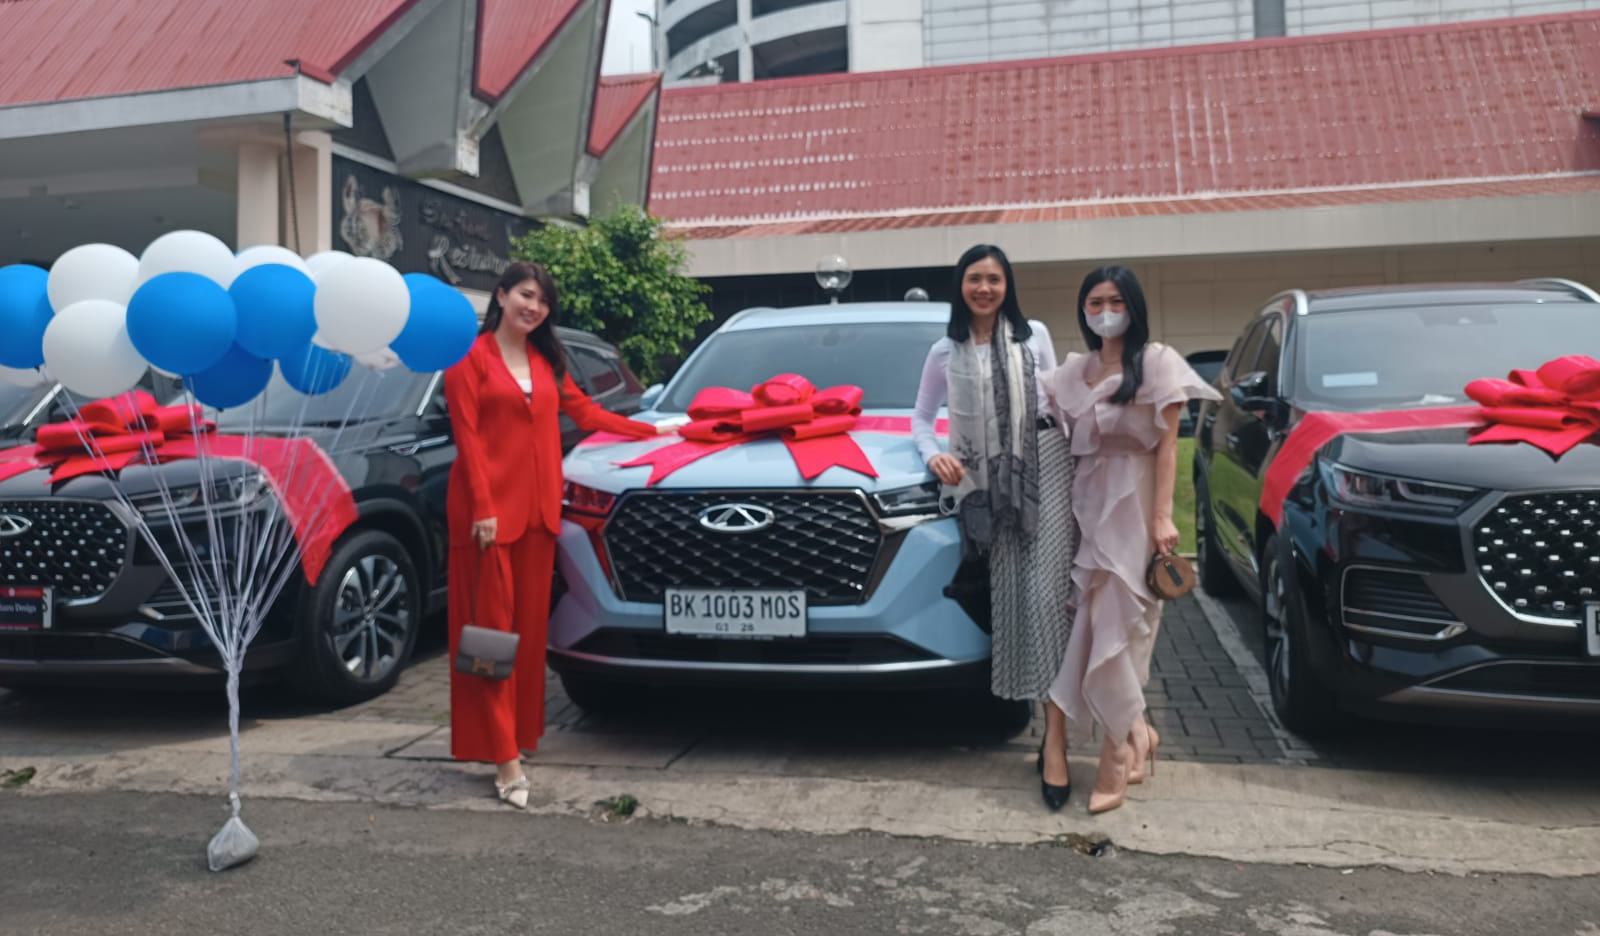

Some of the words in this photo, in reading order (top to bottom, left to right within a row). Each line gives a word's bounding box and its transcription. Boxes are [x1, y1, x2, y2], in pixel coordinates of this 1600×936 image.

[670, 593, 697, 618] BK
[701, 594, 755, 619] 1003
[760, 595, 801, 620] MOS
